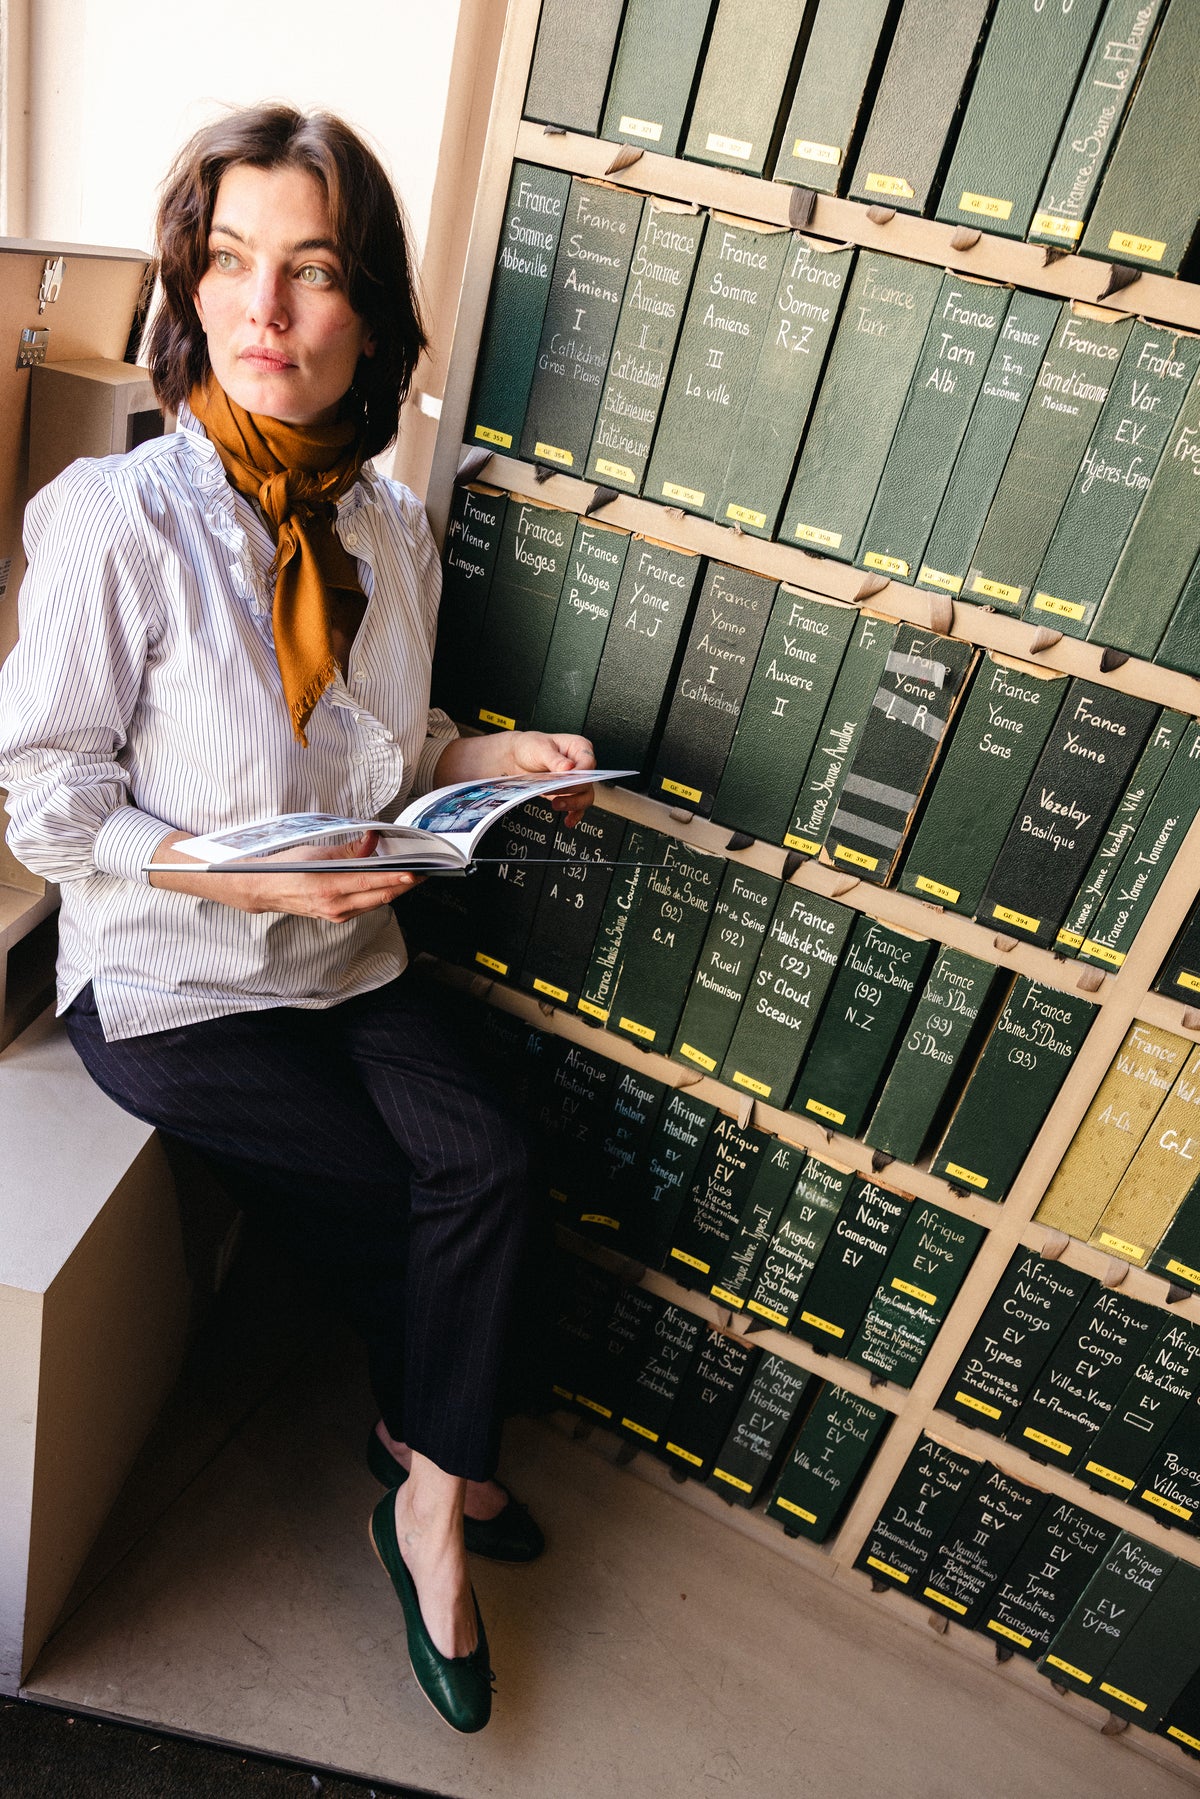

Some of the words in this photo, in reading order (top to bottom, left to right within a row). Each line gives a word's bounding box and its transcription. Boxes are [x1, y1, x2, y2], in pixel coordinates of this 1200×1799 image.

[516, 182, 560, 216] France
[576, 197, 626, 235] France
[640, 206, 695, 255] France
[509, 217, 553, 250] Somme
[1121, 239, 1133, 248] GE
[1137, 243, 1152, 252] 327
[498, 246, 548, 278] Abbeville
[567, 235, 621, 268] Somme
[630, 244, 682, 286] Somme
[720, 232, 768, 270] France
[791, 246, 841, 289] France
[564, 269, 619, 303] Amiens
[629, 280, 676, 318] Amiens
[710, 272, 758, 305] Somme
[779, 284, 830, 322] Somme
[943, 292, 996, 329] France
[572, 309, 587, 331] I
[703, 303, 750, 336] Amiens
[1002, 316, 1041, 346] France
[776, 320, 814, 354] R-Z
[940, 333, 975, 365] Tarn
[1059, 319, 1120, 360] France
[539, 354, 565, 376] Gros
[573, 364, 600, 386] Plans
[705, 349, 724, 369] III
[1002, 355, 1023, 375] Tarn
[1136, 342, 1186, 379] France
[685, 373, 700, 396] La
[706, 384, 730, 405] ville
[925, 367, 958, 394] Albi
[983, 382, 1021, 402] Garonne
[1130, 379, 1159, 411] Var
[1041, 395, 1079, 415] Moissac
[464, 492, 496, 526] France
[517, 506, 564, 547] France
[448, 548, 485, 579] Limoges
[515, 536, 556, 576] Vosges
[579, 531, 619, 564] France
[576, 561, 610, 595] Vosges
[638, 553, 686, 588] France
[568, 588, 609, 620] Paysages
[630, 582, 670, 611] Yonne
[709, 575, 758, 610] France
[983, 584, 994, 592] GE
[996, 587, 1010, 597] 361
[710, 610, 746, 635] Yonne
[788, 603, 829, 636] France
[1058, 604, 1073, 614] 362
[697, 634, 746, 665] Auxerre
[783, 635, 817, 663] Yonne
[706, 666, 719, 684] I
[765, 660, 814, 690] Auxerre
[894, 672, 936, 701] Yonne
[989, 668, 1040, 704] France
[772, 697, 789, 717] II
[989, 702, 1023, 734] Yonne
[1074, 697, 1127, 736] France
[821, 721, 858, 761] Avallon
[979, 733, 1011, 759] Sens
[1063, 731, 1106, 764] Yonne
[1153, 727, 1172, 749] Fr.
[810, 761, 842, 799] Yonne
[795, 798, 829, 836] France
[1040, 788, 1091, 830] Vezelay
[502, 816, 546, 846] Essonne
[1020, 815, 1075, 851] Basilique
[663, 843, 712, 885] France
[1065, 902, 1093, 935] France
[1086, 865, 1109, 896] Yonne
[1101, 820, 1135, 860] Vezelay
[1121, 788, 1145, 811] Ville
[732, 878, 768, 906] France
[661, 901, 683, 923] (92)
[790, 901, 835, 935] France
[1003, 912, 1014, 920] GE
[1015, 915, 1028, 926] 394
[1092, 909, 1128, 948] France
[1118, 872, 1148, 902] Yonne
[721, 928, 744, 948] (92)
[770, 918, 799, 949] Hauts
[799, 934, 812, 955] de
[812, 938, 838, 967] Seine
[865, 926, 911, 964] France
[710, 952, 741, 976] Rueil
[780, 954, 811, 979] (92)
[844, 944, 873, 977] Hauts
[873, 969, 883, 981] de
[883, 961, 914, 992] Seine
[936, 960, 975, 991] France
[696, 970, 742, 1003] Malmaison
[774, 978, 811, 1008] Cloud
[854, 981, 882, 1006] (92)
[756, 997, 802, 1030] Sceaux
[1022, 984, 1073, 1024] France
[926, 1013, 953, 1037] (93)
[1008, 1047, 1037, 1070] (93)
[1128, 1027, 1177, 1064] France
[668, 1096, 706, 1131] Afrique
[714, 1120, 760, 1153] Afrique
[716, 1142, 747, 1170] Noire
[801, 1157, 843, 1192] Afrique
[858, 1183, 902, 1217] Afrique
[779, 1220, 816, 1250] Angola
[855, 1204, 889, 1234] Noire
[916, 1209, 965, 1244] Afrique
[836, 1220, 887, 1256] Cameroun
[918, 1232, 954, 1262] Noire
[1017, 1259, 1075, 1297] Afrique
[1014, 1281, 1051, 1310] Noire
[1003, 1299, 1050, 1332] Congo
[1093, 1294, 1149, 1331] Afrique
[706, 1330, 748, 1361] Afrique
[1002, 1327, 1026, 1345] EV
[1089, 1318, 1128, 1346] Noire
[984, 1336, 1022, 1368] Types
[1078, 1335, 1122, 1367] Congo
[1155, 1348, 1189, 1376] Noire
[696, 1361, 735, 1392] Histoire
[761, 1355, 803, 1390] Afrique
[967, 1359, 1019, 1393] Danses
[1075, 1360, 1101, 1379] EV
[748, 1389, 790, 1421] Histoire
[830, 1385, 877, 1421] Afrique
[962, 1371, 1022, 1408] Industries
[749, 1412, 774, 1432] EV
[826, 1427, 847, 1444] EV
[827, 1411, 840, 1426] du
[842, 1417, 869, 1442] Sud
[919, 1442, 970, 1476] Afrique
[920, 1482, 942, 1498] EV
[986, 1473, 1033, 1505] Afrique
[892, 1506, 933, 1539] Durban
[1053, 1504, 1107, 1541] Afrique
[1050, 1545, 1072, 1562] EV
[1116, 1542, 1163, 1577] Afrique
[998, 1583, 1056, 1623] Industries
[1026, 1573, 1055, 1601] Types
[996, 1601, 1050, 1644] Transports
[1082, 1608, 1121, 1638] Types
[1096, 1598, 1126, 1619] EV
